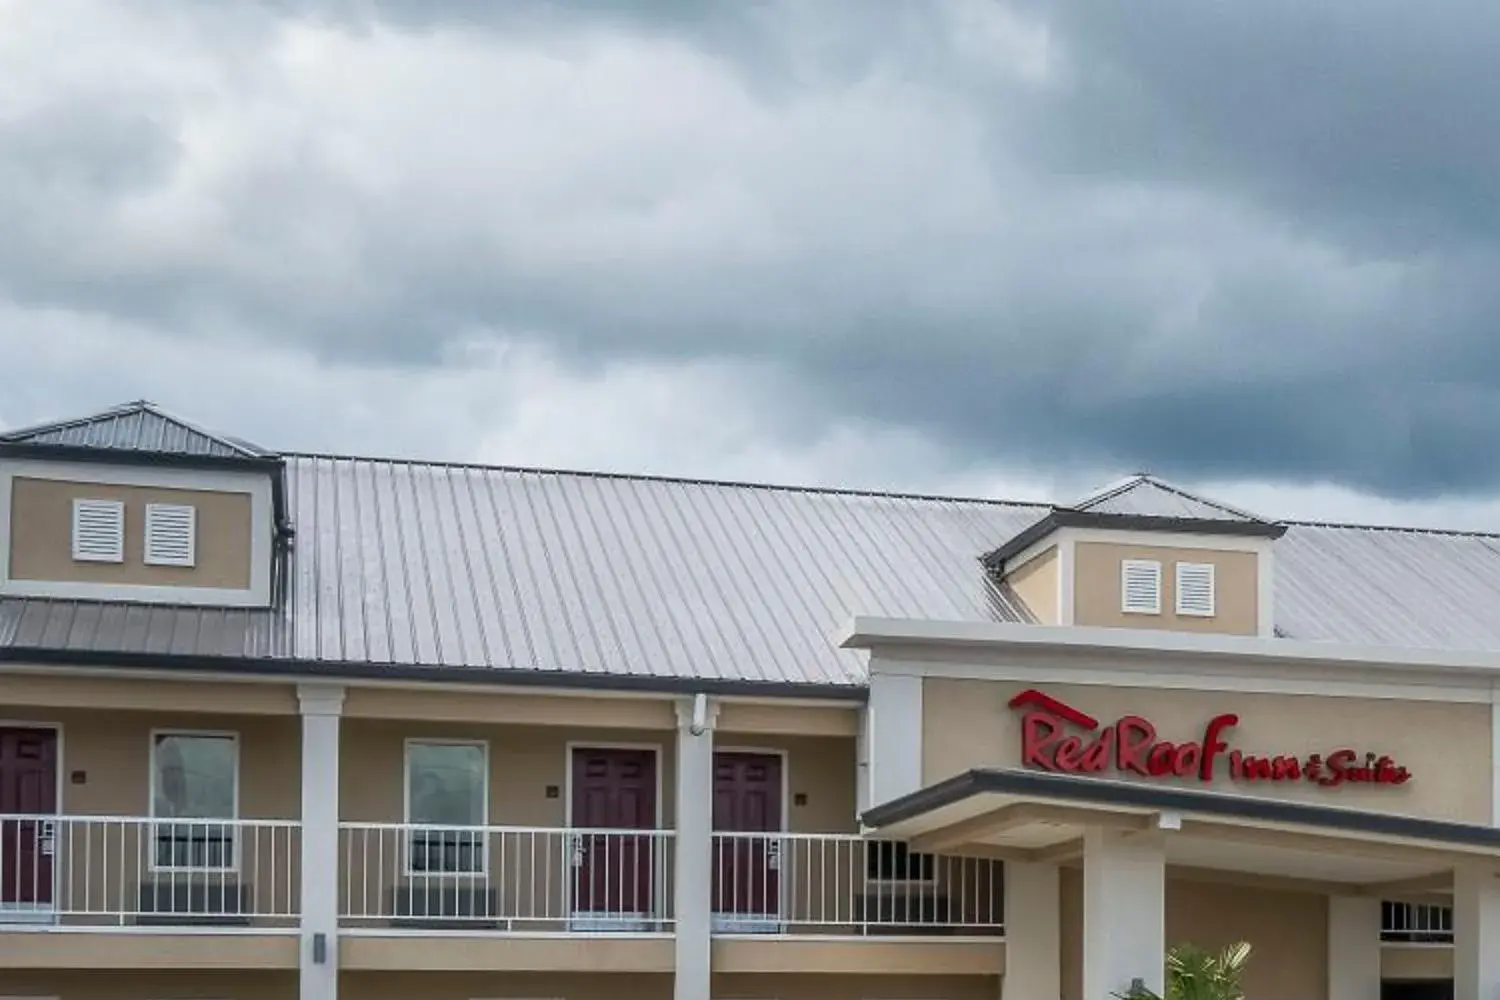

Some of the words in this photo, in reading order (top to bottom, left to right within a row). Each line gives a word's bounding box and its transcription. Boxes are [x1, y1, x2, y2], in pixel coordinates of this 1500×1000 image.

[1022, 711, 1118, 774] Red
[1116, 714, 1239, 782] Roof
[1302, 752, 1322, 783] &
[1318, 748, 1413, 788] Suites
